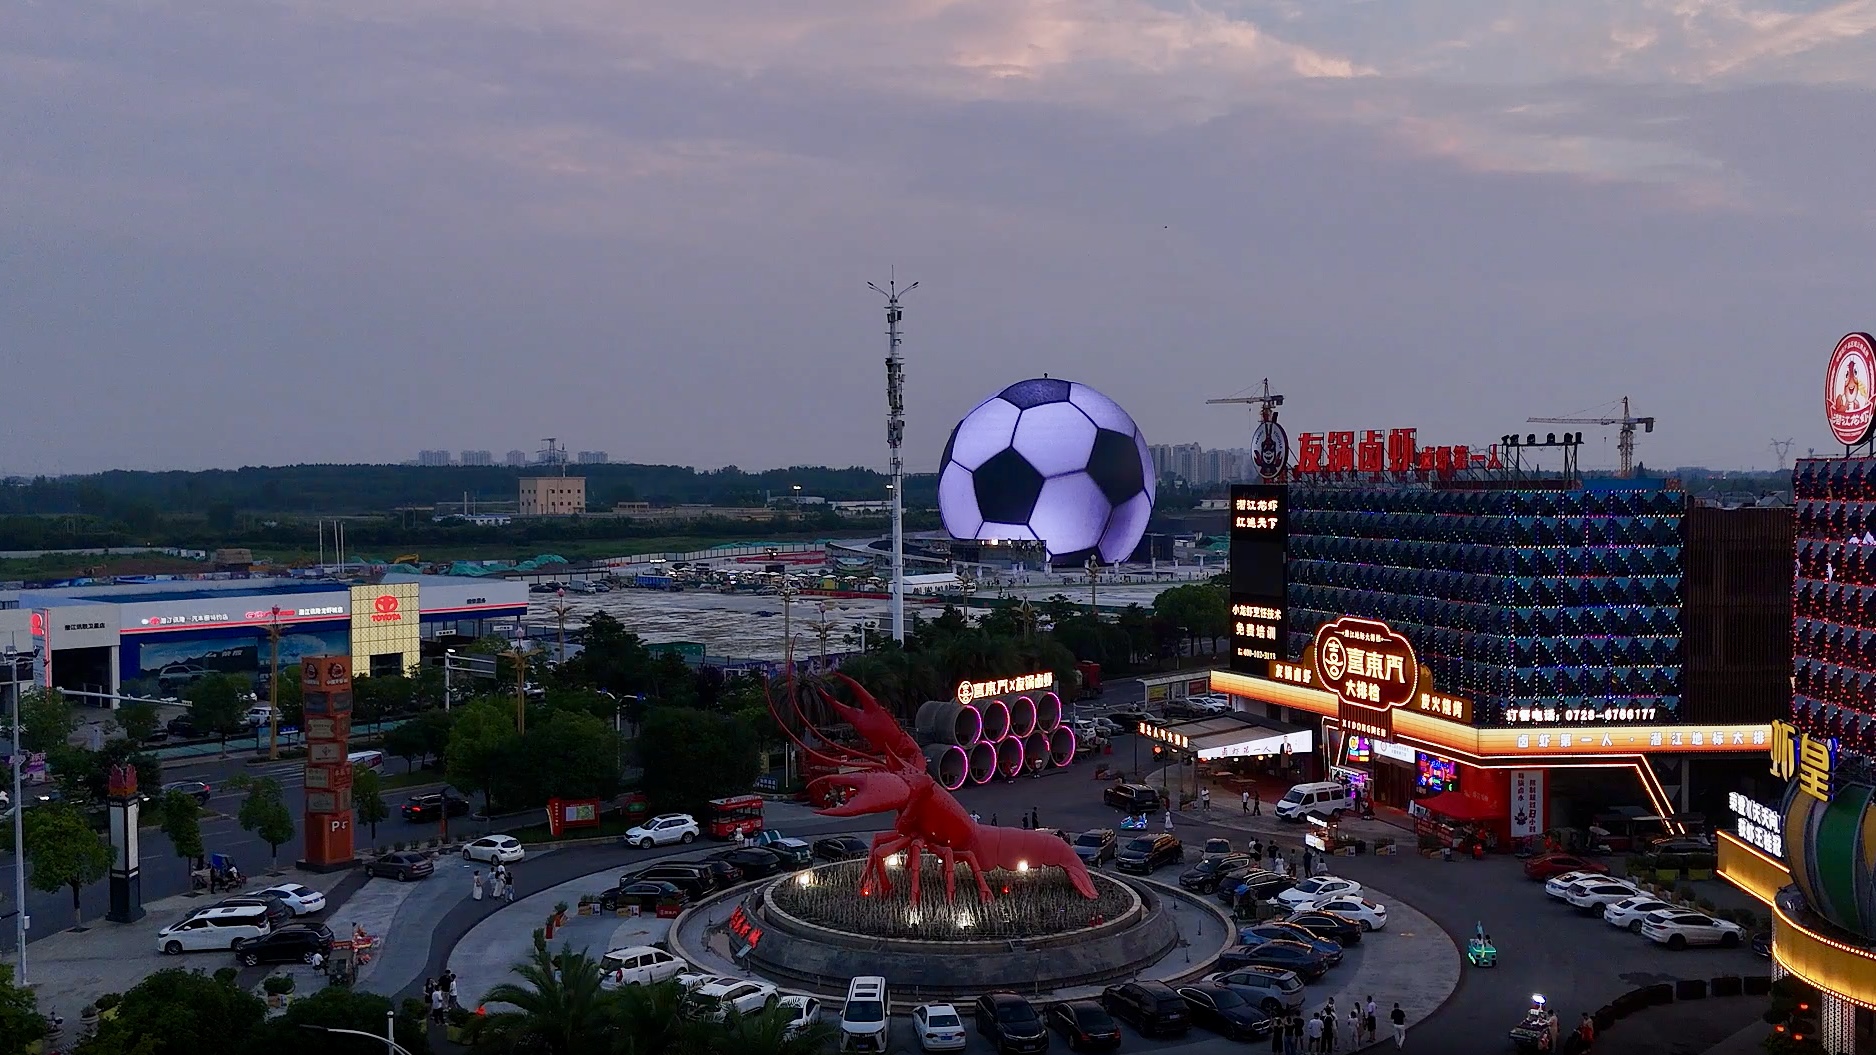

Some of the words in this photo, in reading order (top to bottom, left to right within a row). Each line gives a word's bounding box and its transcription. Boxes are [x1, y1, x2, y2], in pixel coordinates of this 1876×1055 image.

[1298, 428, 1417, 472] 友锅卤虾
[1418, 444, 1504, 470] 卤虾第一人
[1236, 499, 1278, 512] 潜江龙虾
[371, 613, 402, 622] TOYOTA
[1232, 604, 1282, 621] 小龙虾烹饪技术
[1236, 622, 1276, 640] 免费培训
[1275, 663, 1312, 684] 友锅卤虾
[1345, 679, 1381, 702] 大排档
[1421, 693, 1463, 719] 炭火烧烤
[1342, 719, 1387, 738] XIDONGMEN
[331, 821, 340, 832] P
